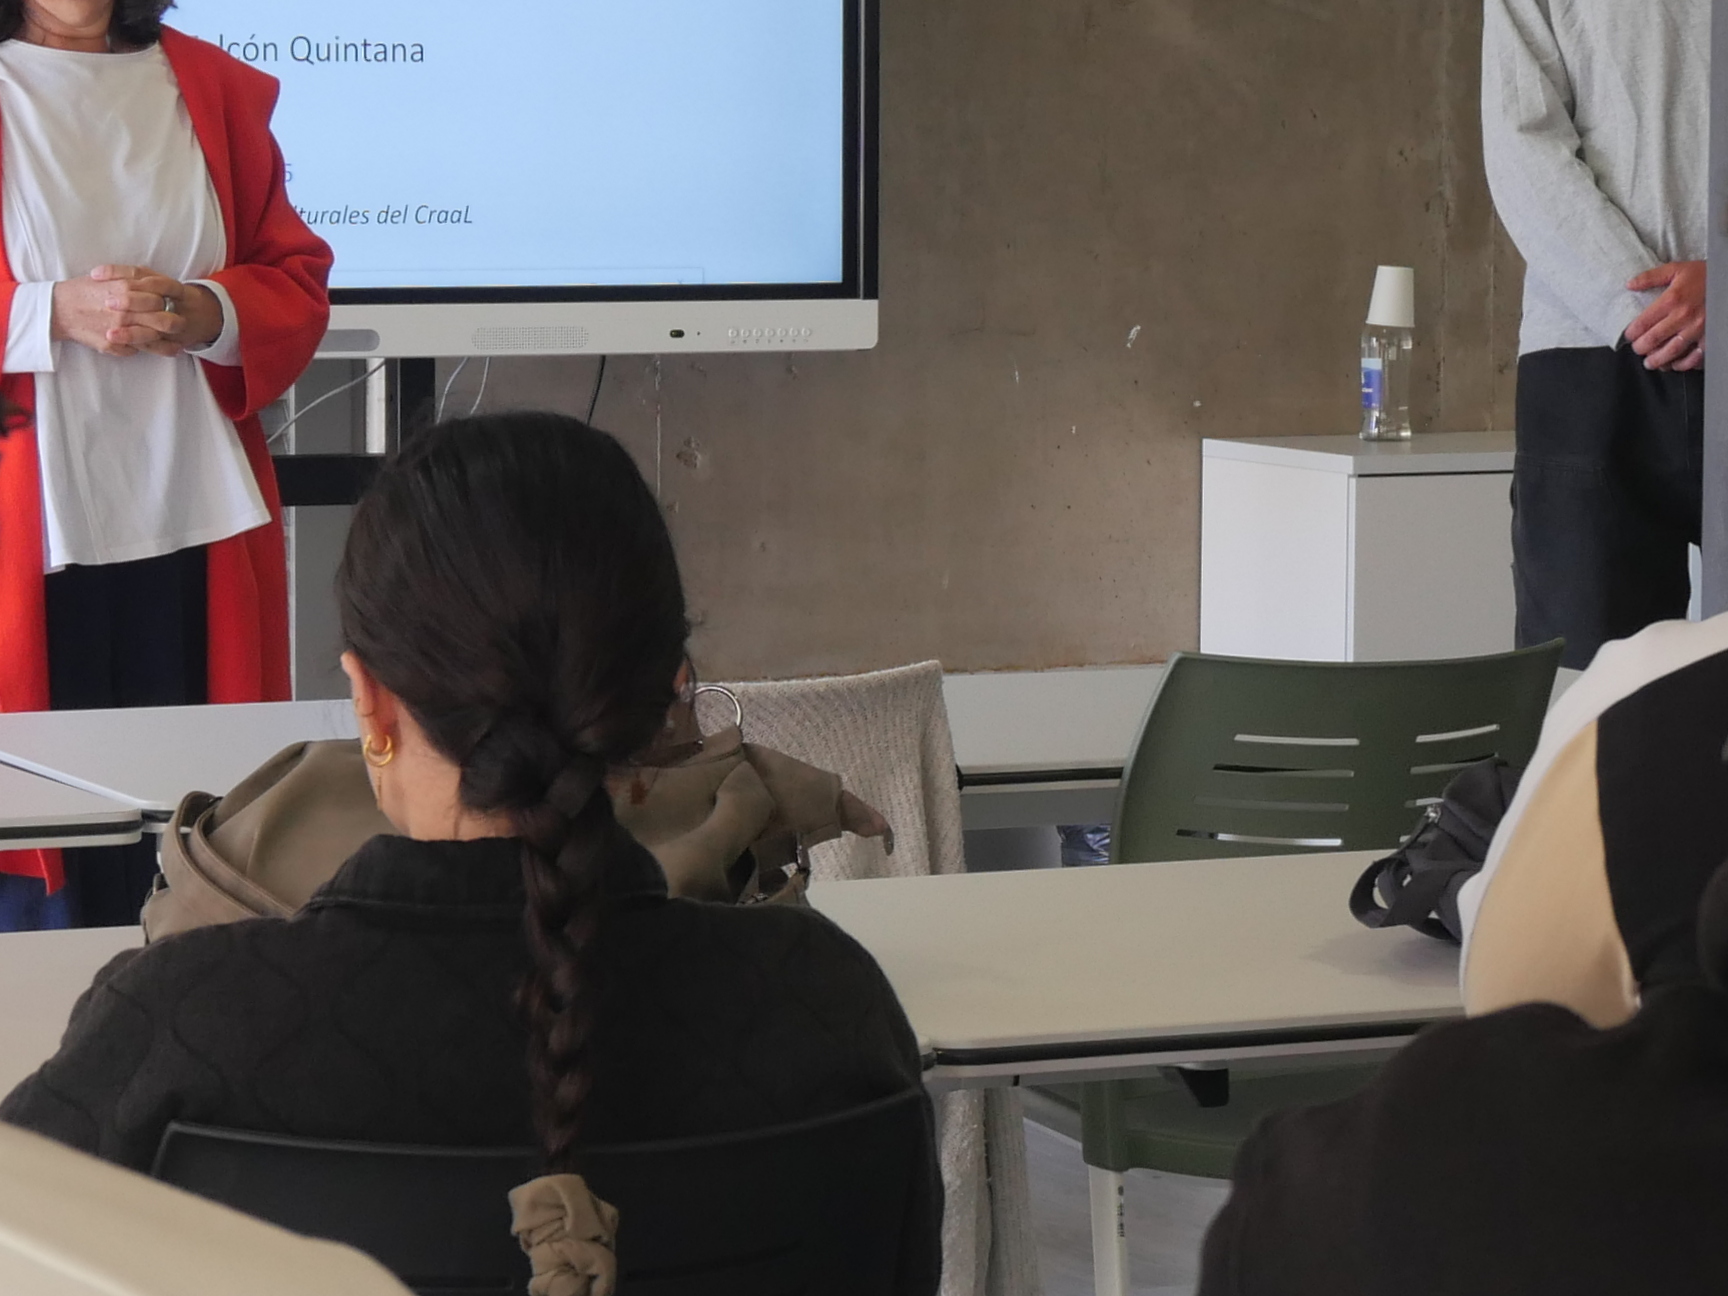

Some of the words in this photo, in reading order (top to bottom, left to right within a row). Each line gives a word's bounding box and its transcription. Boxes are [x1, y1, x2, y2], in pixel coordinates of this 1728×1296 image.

[192, 34, 278, 62] lcón
[290, 35, 425, 65] Quintana
[377, 205, 408, 225] del
[415, 205, 473, 224] CraaL
